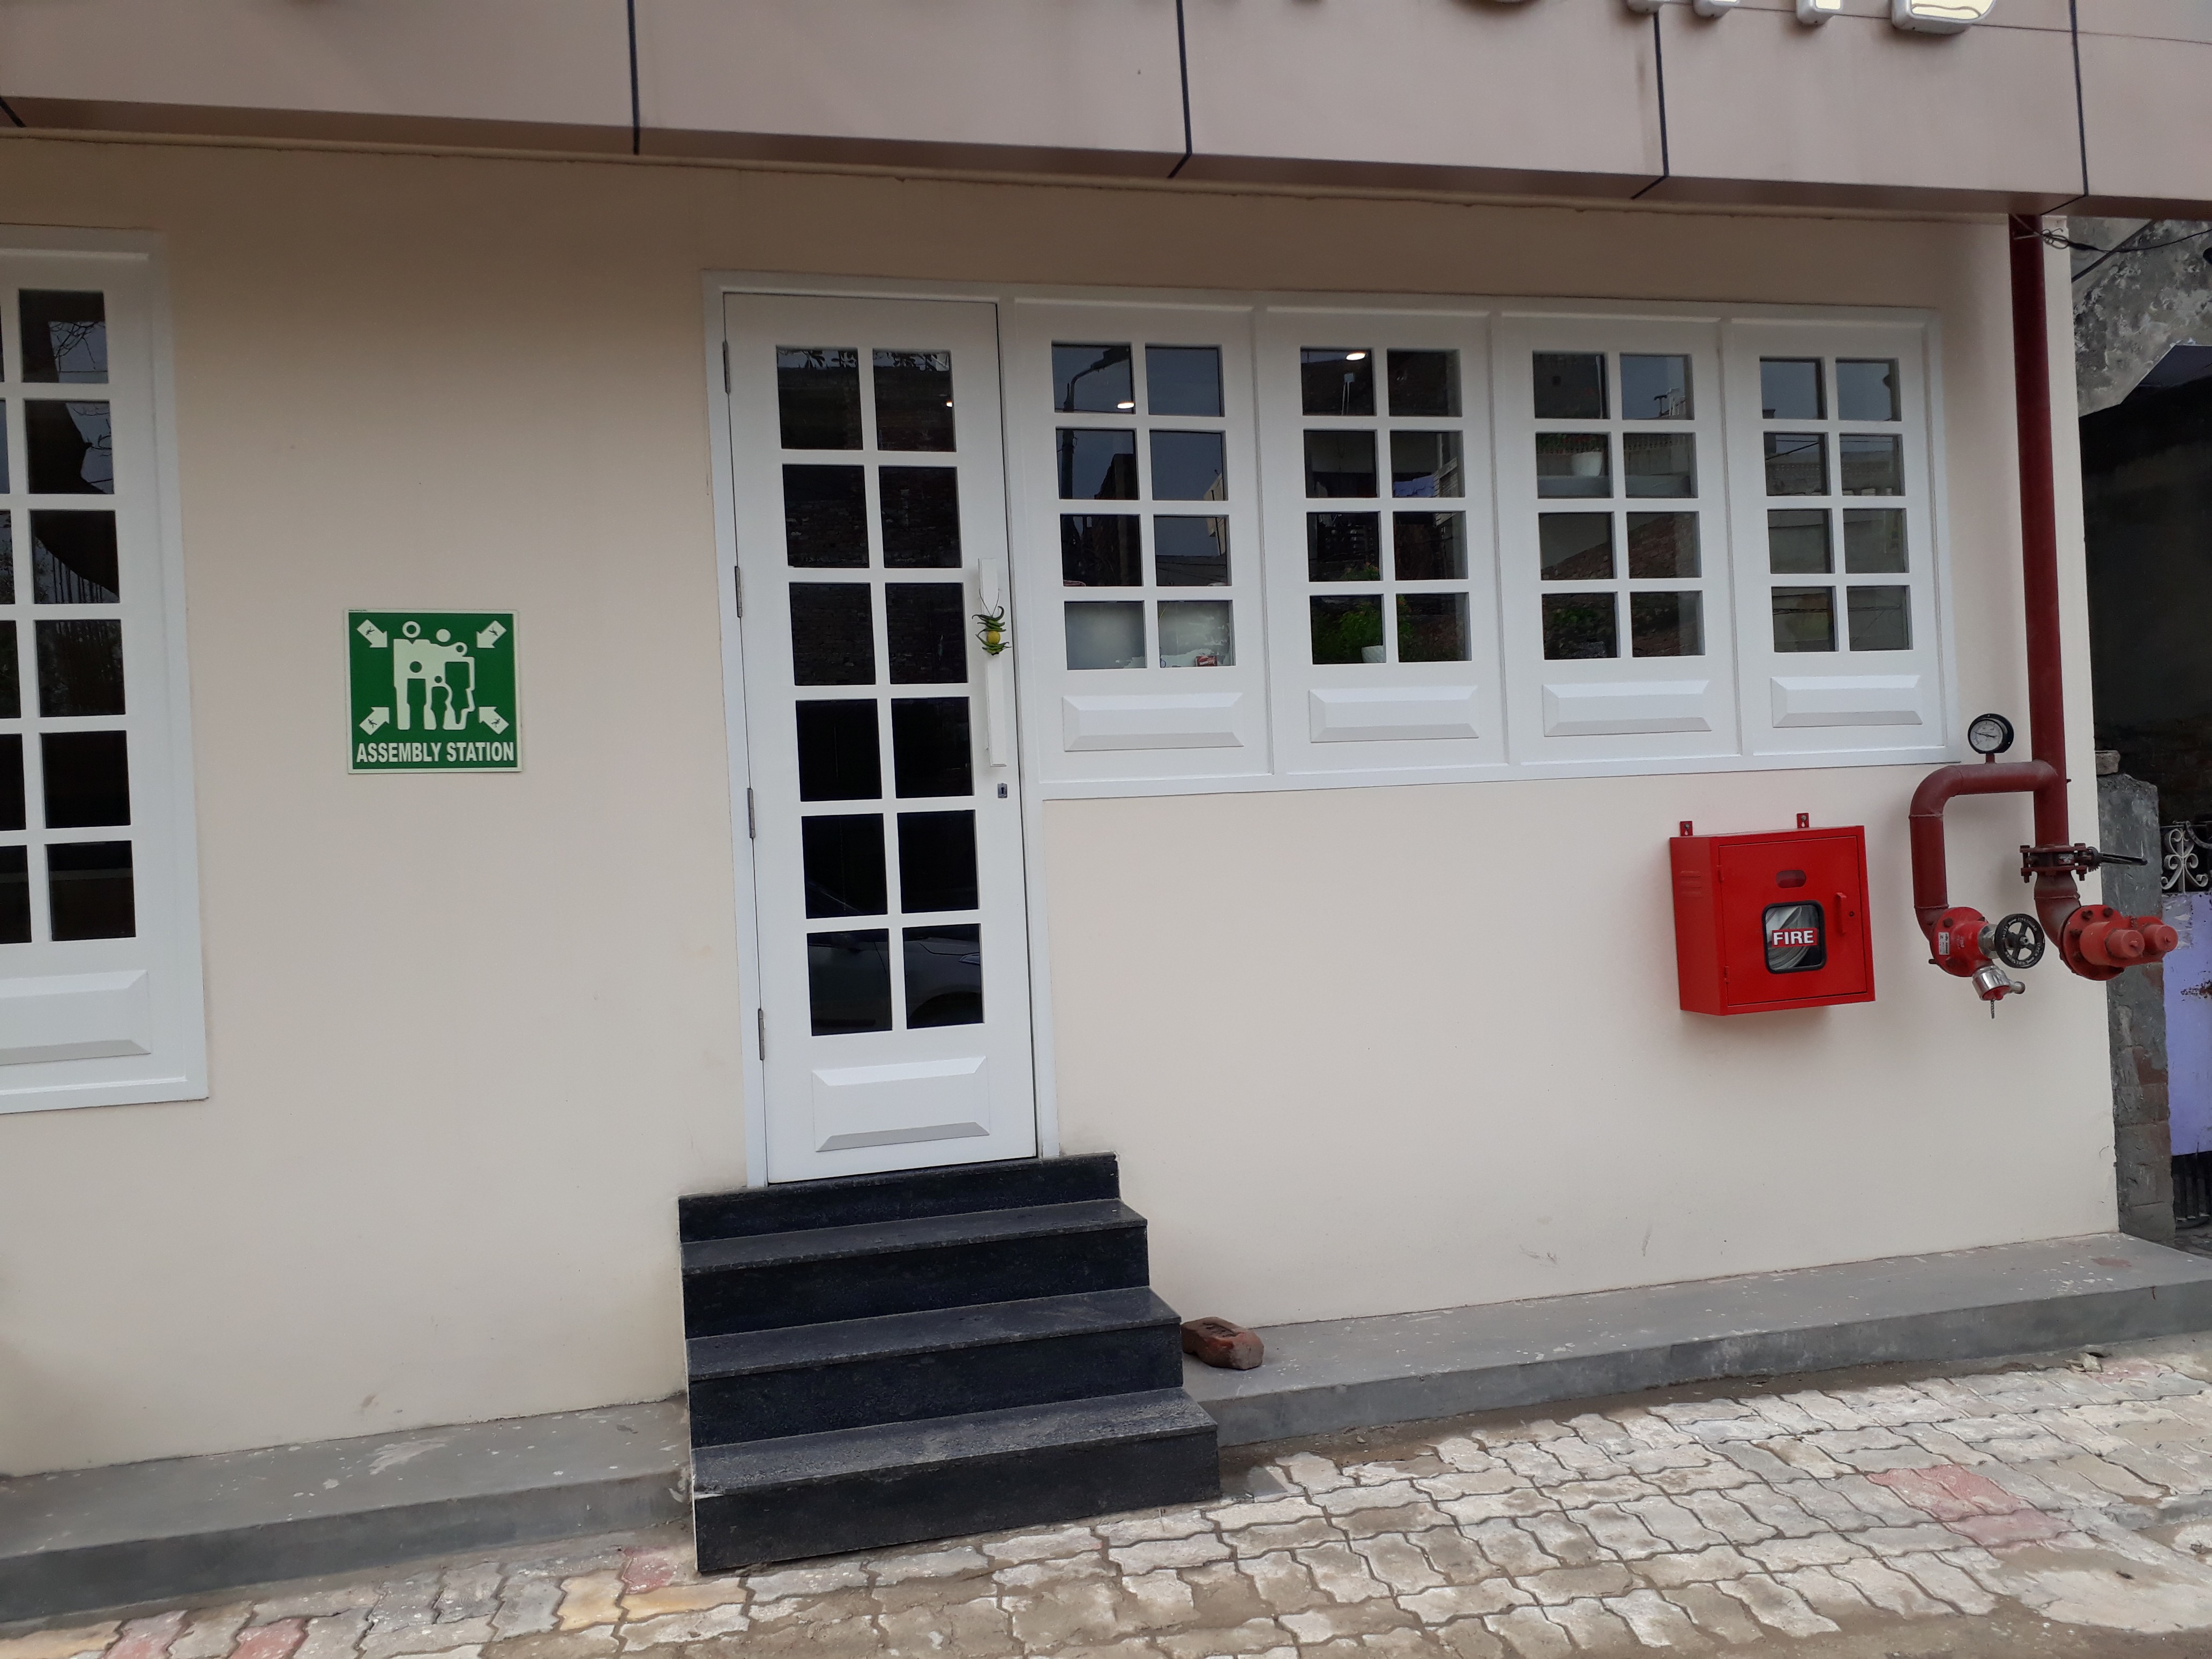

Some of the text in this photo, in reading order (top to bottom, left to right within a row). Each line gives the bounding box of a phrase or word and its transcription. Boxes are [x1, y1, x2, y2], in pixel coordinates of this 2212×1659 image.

[356, 742, 514, 763] ASSEMBLY STATION
[1773, 930, 1814, 945] FIRE
